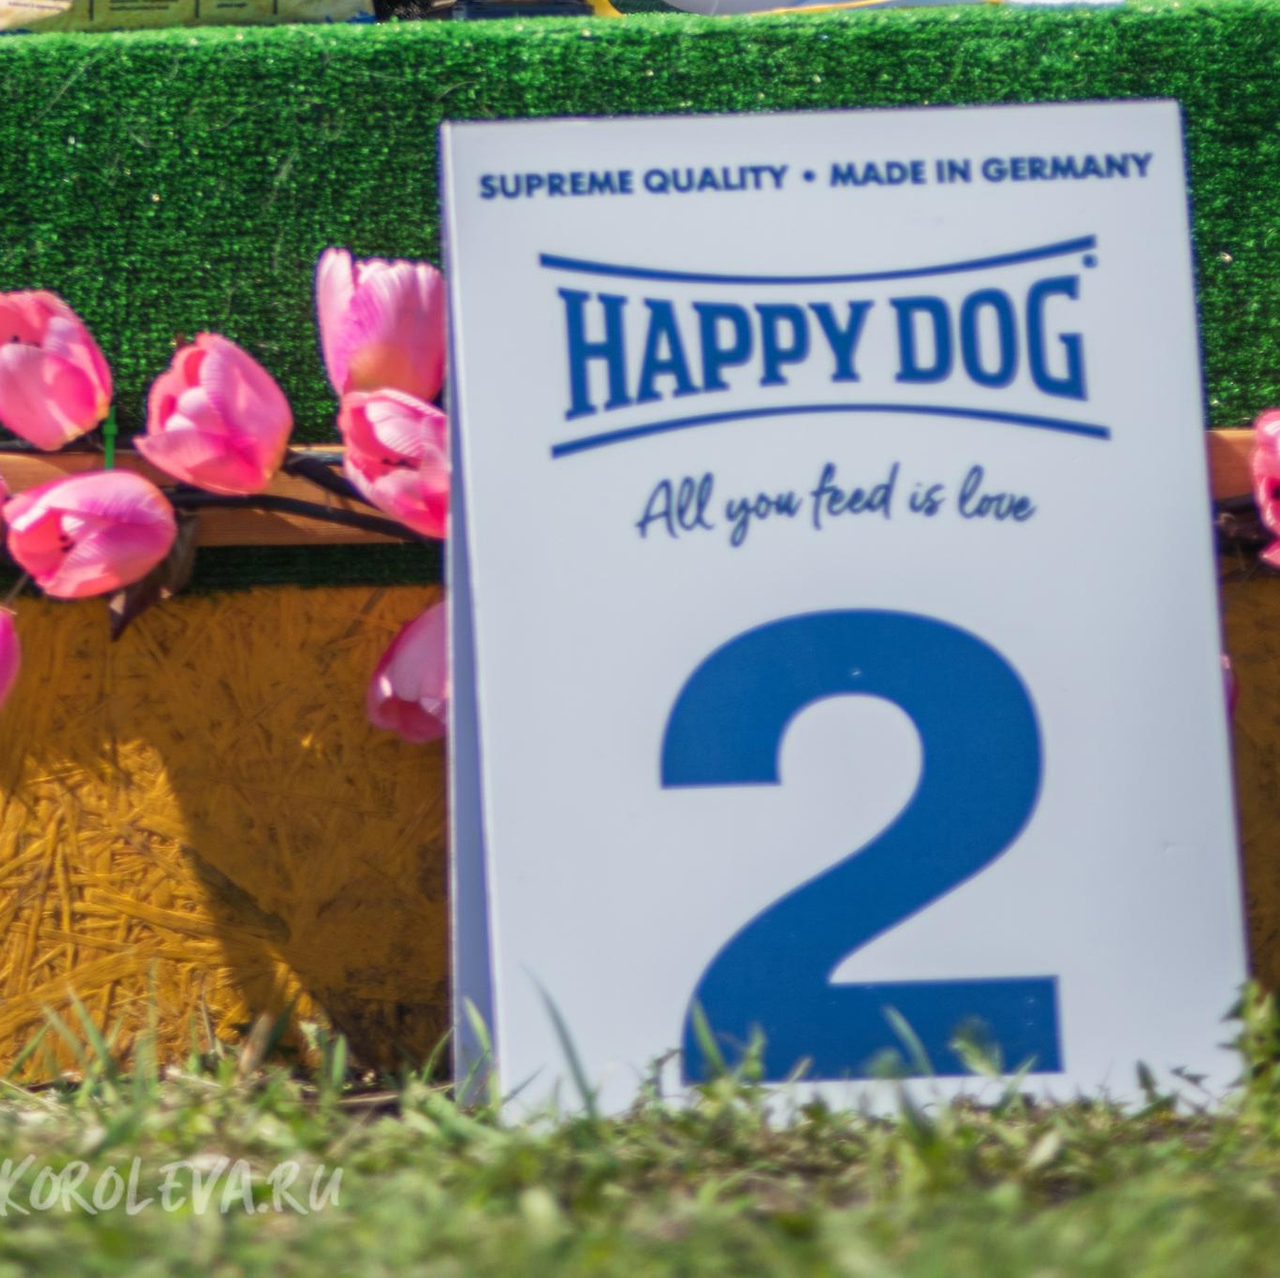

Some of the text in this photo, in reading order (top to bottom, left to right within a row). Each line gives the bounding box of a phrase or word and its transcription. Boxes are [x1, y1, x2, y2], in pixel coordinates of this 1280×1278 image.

[479, 152, 1153, 200] SUPREME QUALITY MADE IN GERMANY
[558, 274, 1088, 421] HAPPY DOG
[635, 461, 1038, 548] All you feed is love
[659, 607, 1065, 1087] 2
